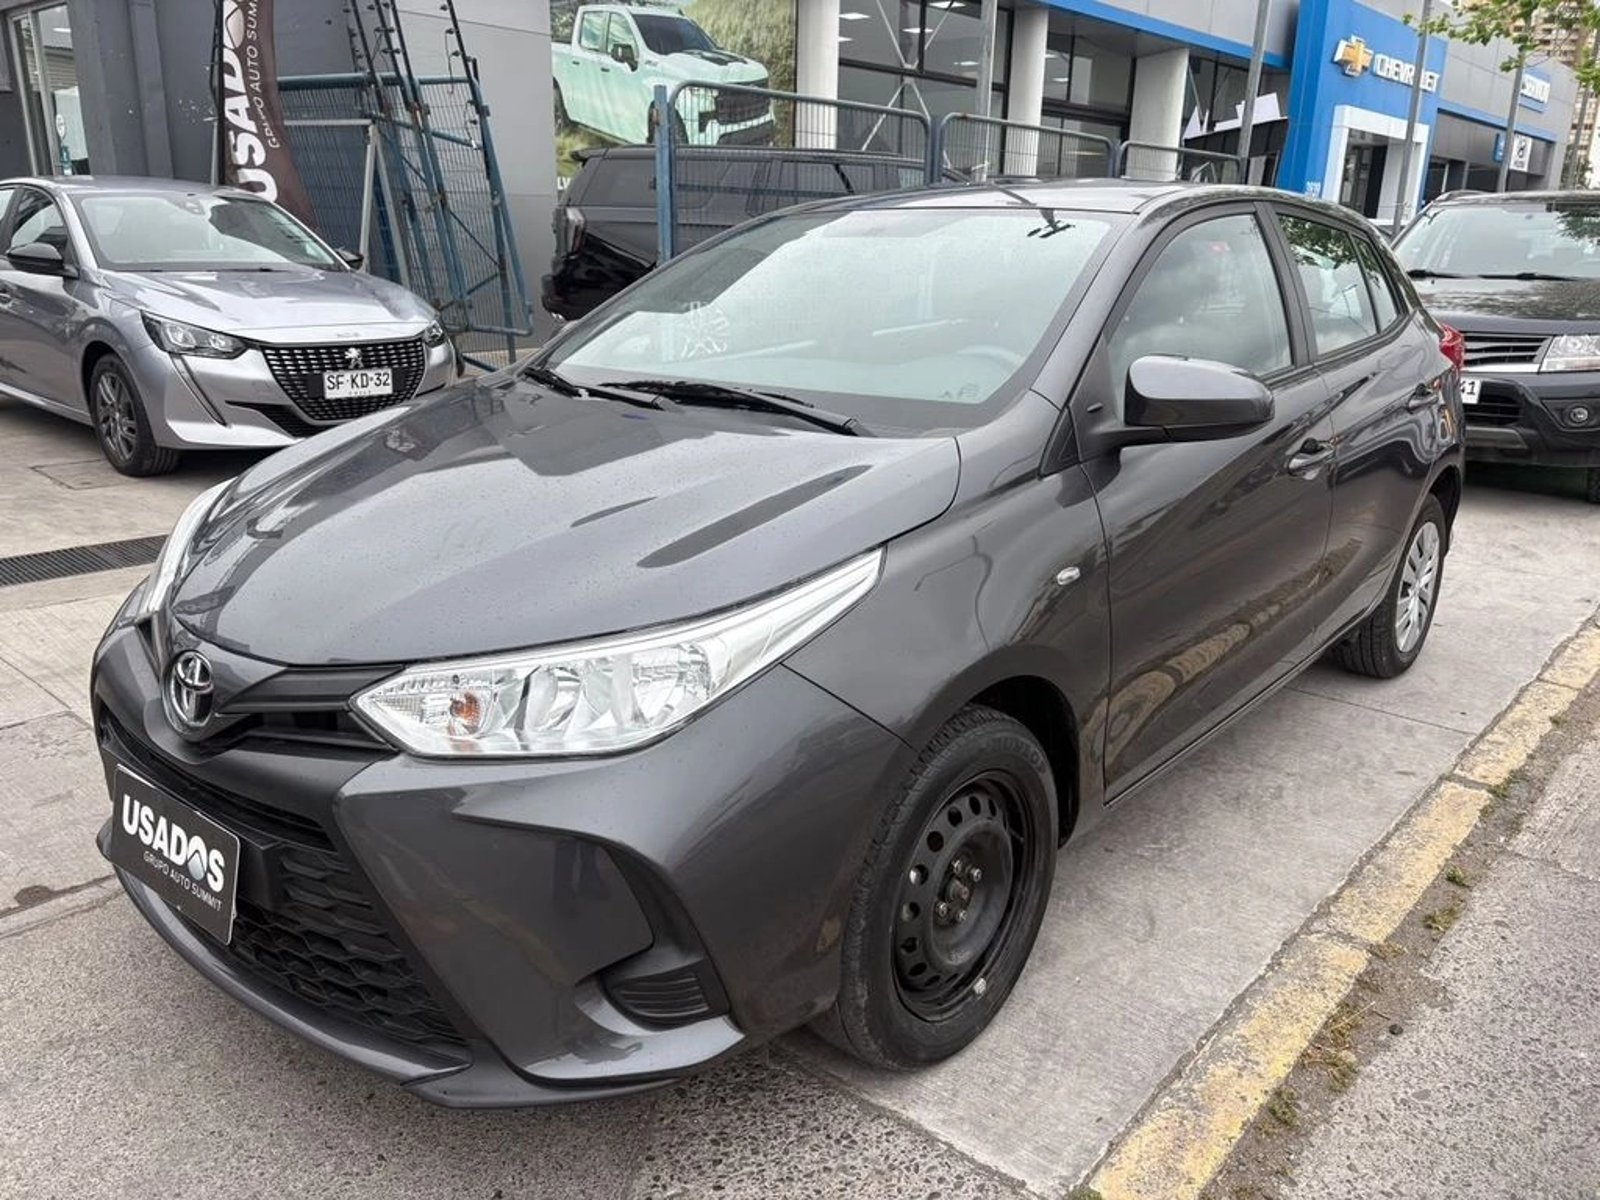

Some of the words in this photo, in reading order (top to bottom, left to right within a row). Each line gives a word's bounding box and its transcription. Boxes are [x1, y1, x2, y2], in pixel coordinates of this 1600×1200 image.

[246, 45, 262, 92] AUTO
[1373, 53, 1440, 93] CHEVRLET
[223, 0, 278, 202] USADO
[122, 794, 225, 893] USADOS
[143, 850, 169, 875] GRUPO
[169, 871, 191, 890] AUTO
[191, 884, 222, 911] SUMMIT
